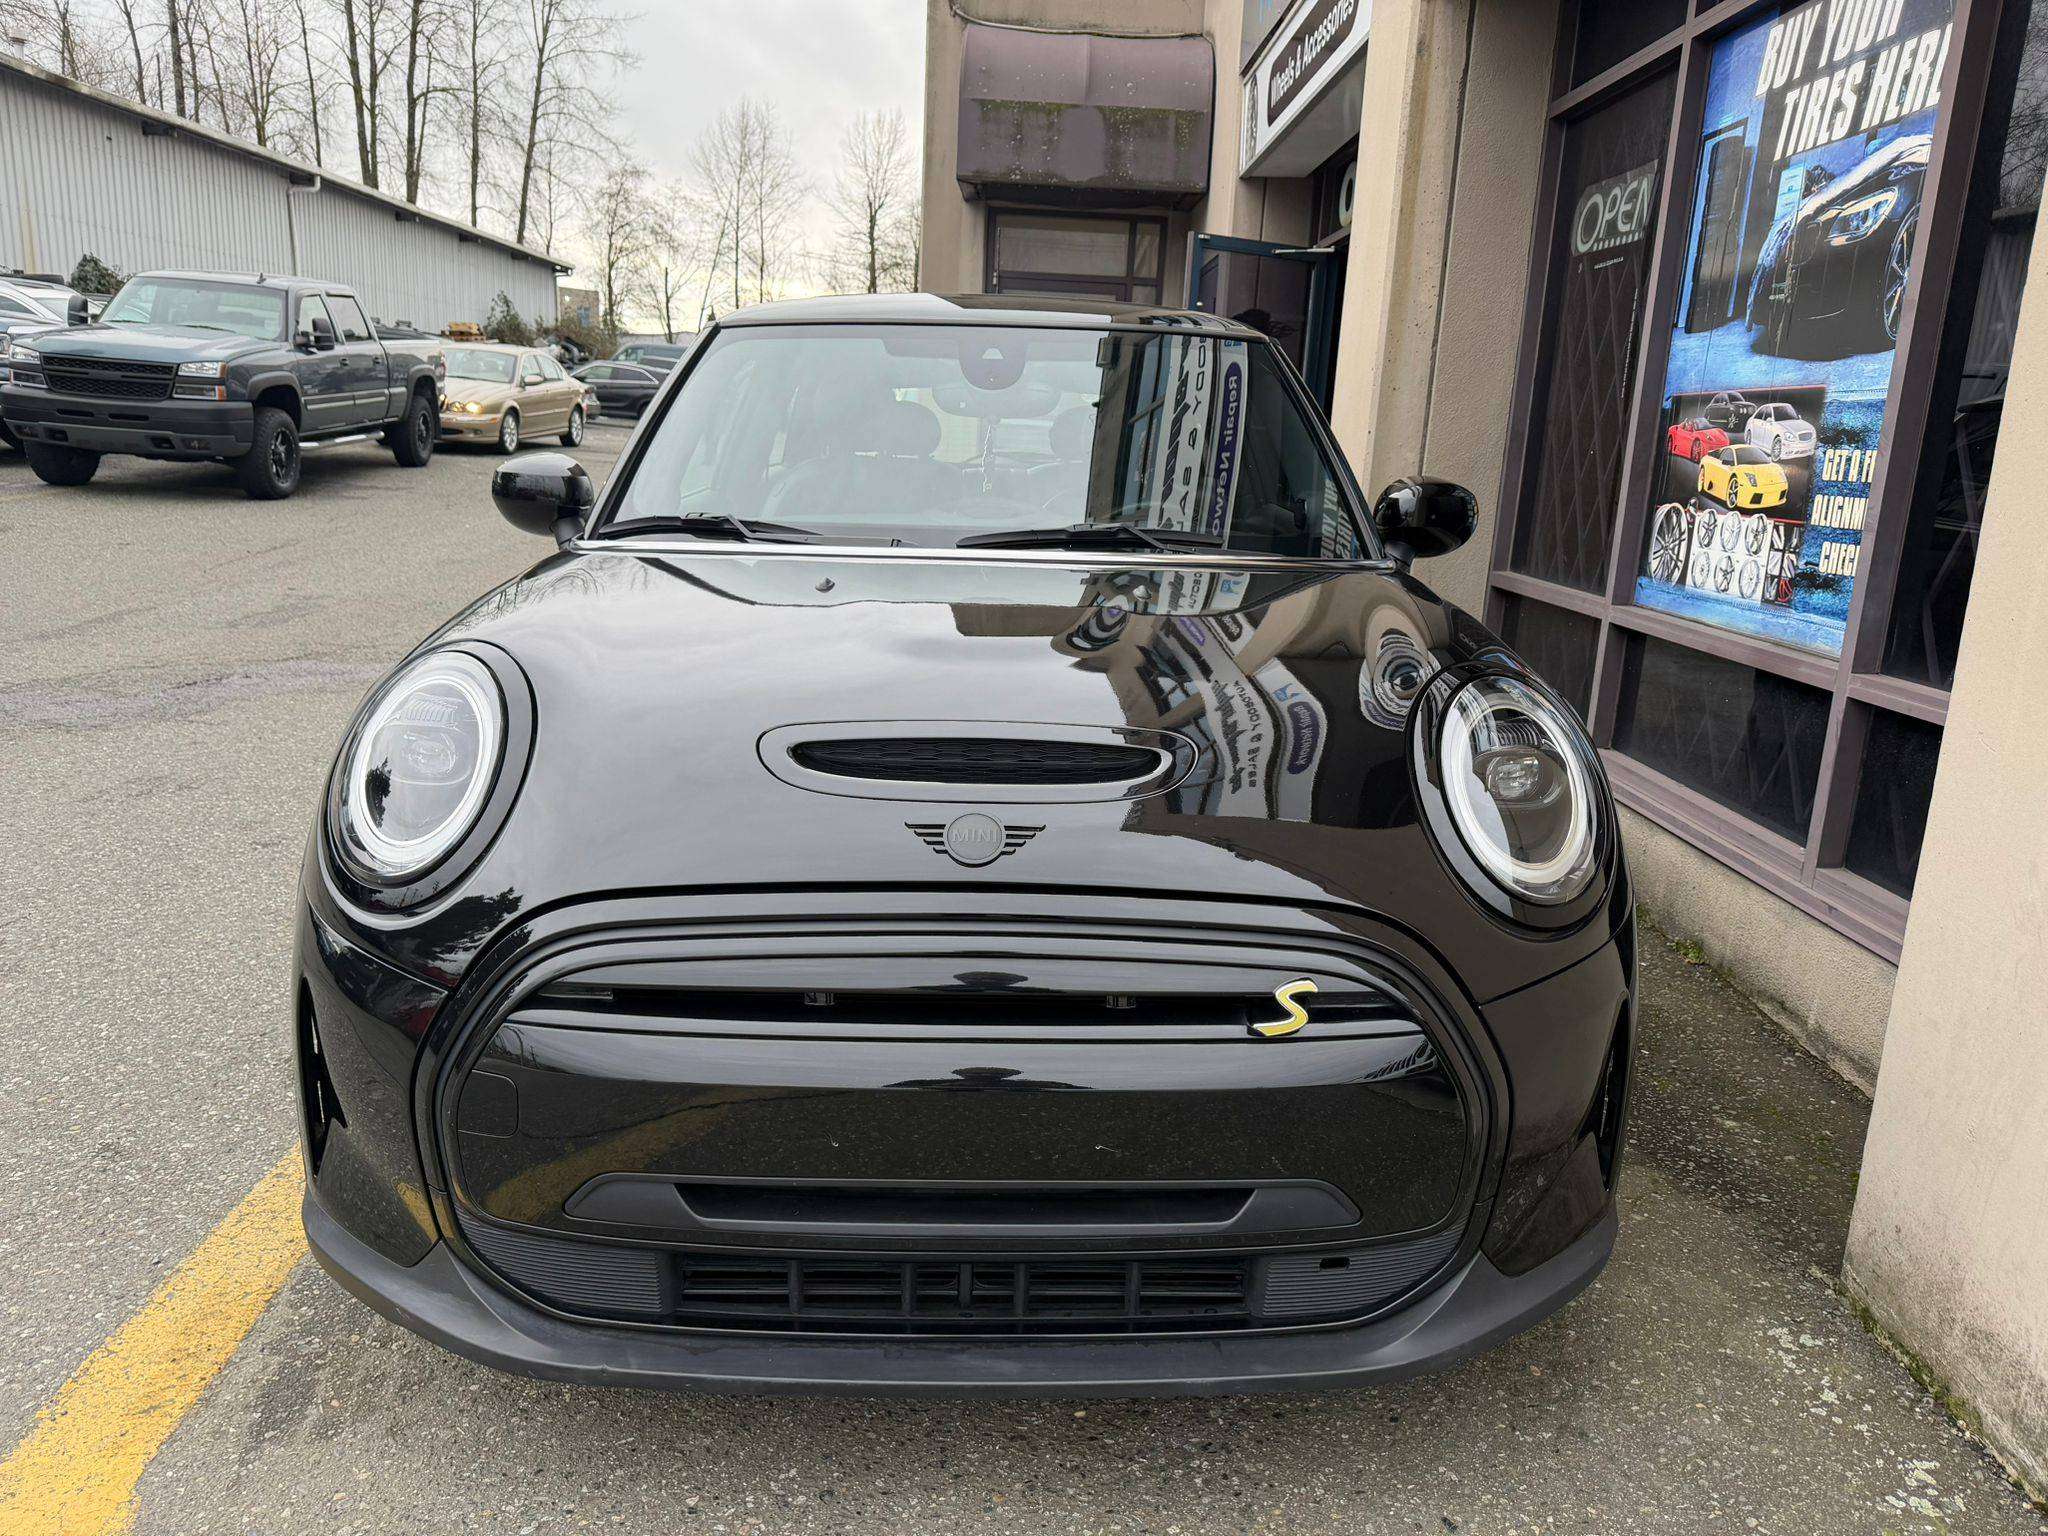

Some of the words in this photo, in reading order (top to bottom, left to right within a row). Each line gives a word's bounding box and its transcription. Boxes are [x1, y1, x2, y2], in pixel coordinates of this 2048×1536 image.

[1755, 2, 1824, 97] BUY
[1270, 56, 1295, 109] Wheels
[1773, 60, 1866, 161] TIRES
[1576, 177, 1649, 253] OPEN
[1822, 449, 1849, 481] GET
[1848, 449, 1861, 482] A
[1811, 494, 1869, 530] ALIGNM
[951, 827, 999, 842] MINI
[1252, 979, 1318, 1036] S
